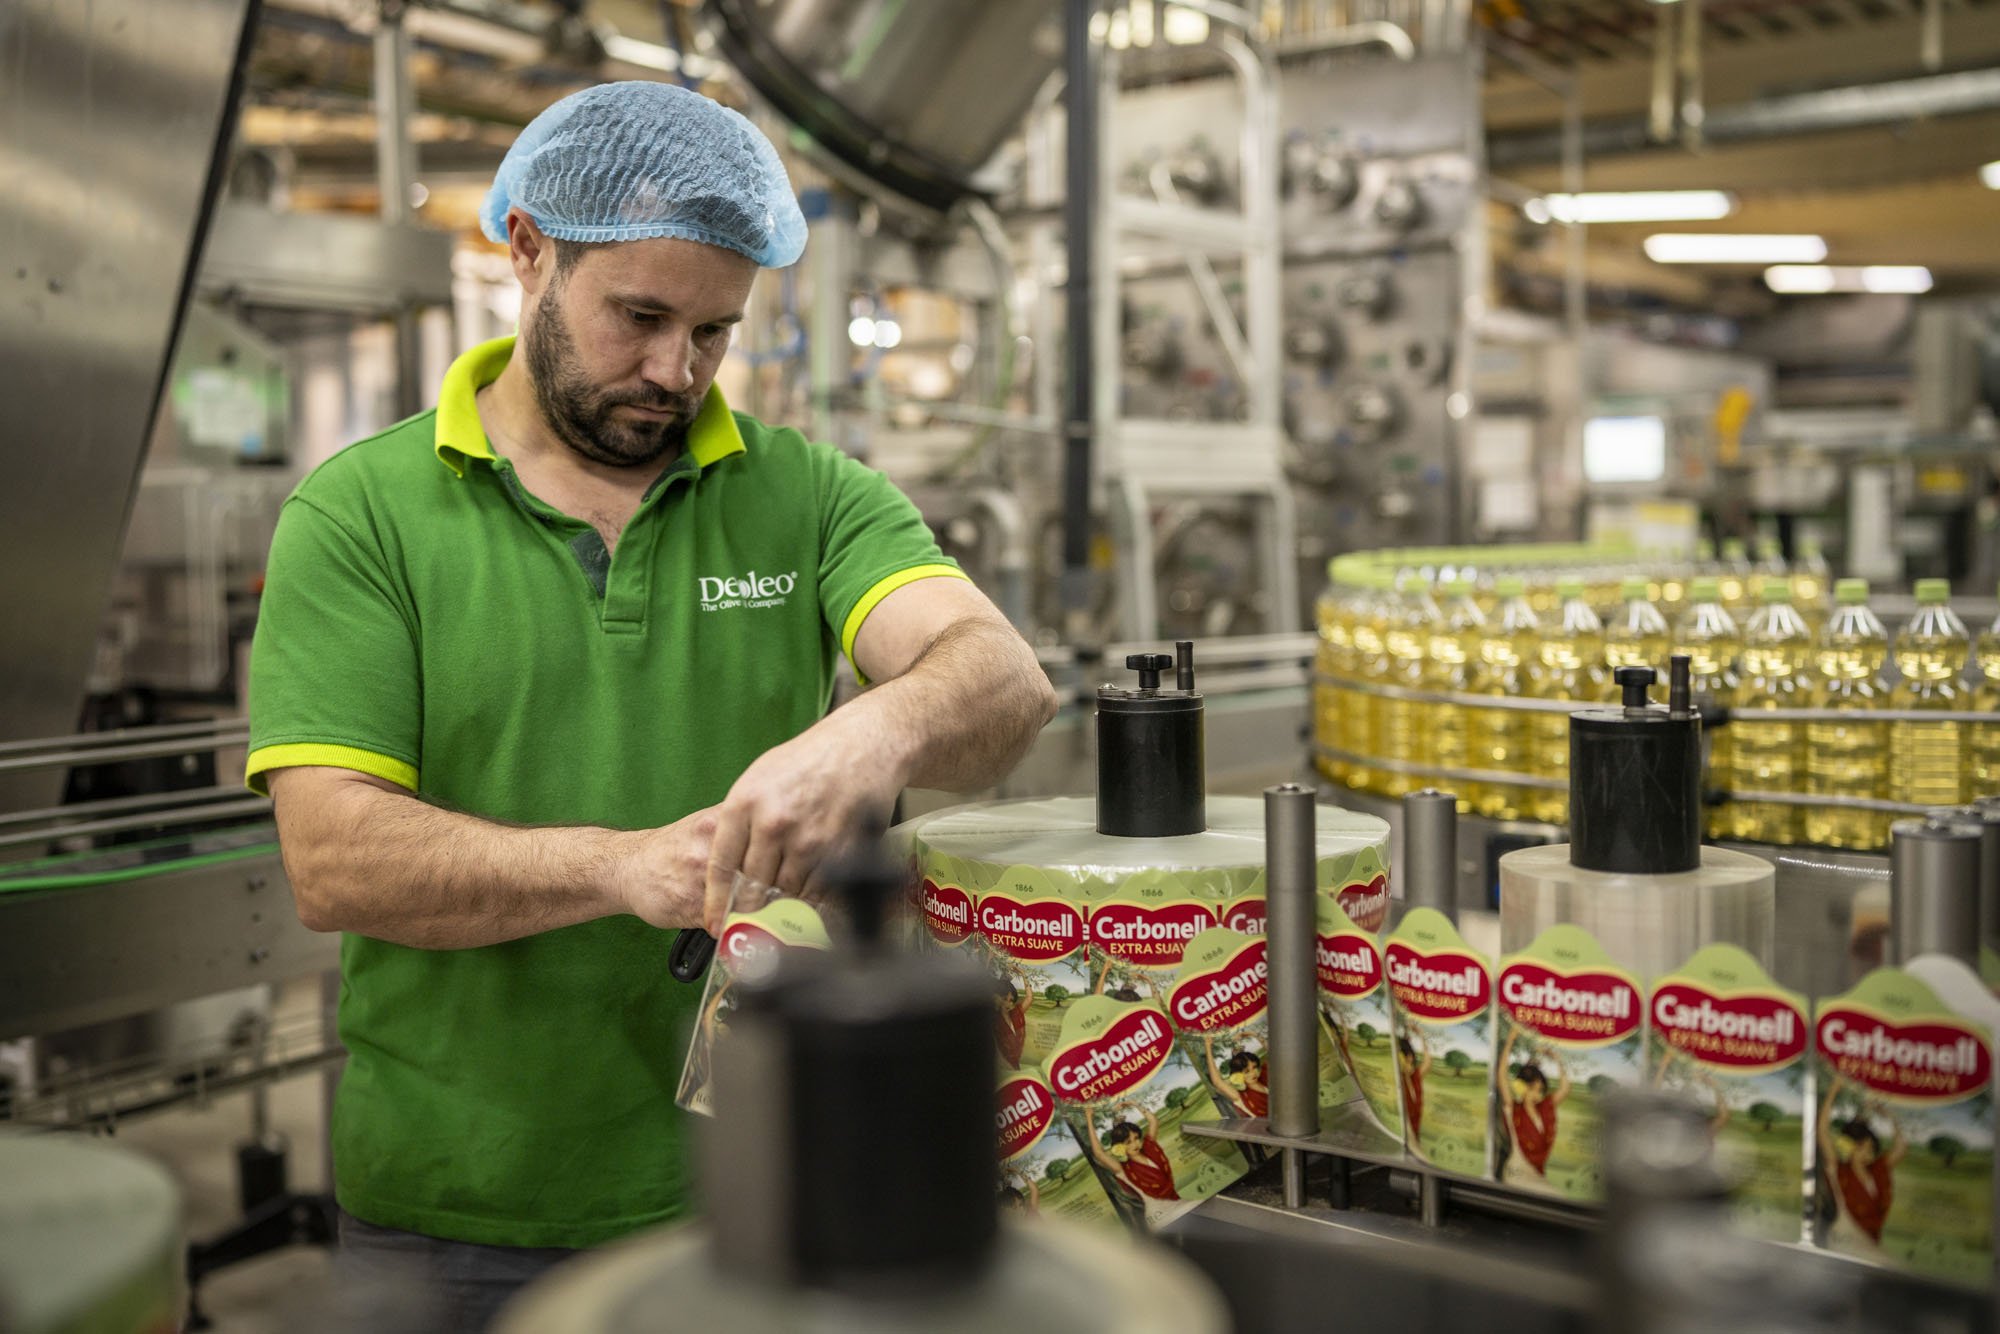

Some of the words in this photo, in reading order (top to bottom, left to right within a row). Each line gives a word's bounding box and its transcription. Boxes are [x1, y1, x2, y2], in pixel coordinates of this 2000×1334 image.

[701, 603, 718, 612] The
[719, 600, 742, 610] Olive
[1015, 884, 1034, 893] 1866
[1140, 889, 1163, 897] 1866
[923, 889, 968, 924] Carbonell
[926, 914, 941, 930] EXTRA
[941, 922, 962, 937] SUAVE
[982, 907, 1074, 938] Carbonell
[992, 933, 1026, 948] EXTRA
[1027, 938, 1064, 952] SUAVE
[1110, 942, 1153, 955] EXTRA
[1154, 942, 1186, 955] SUAV
[1177, 950, 1268, 1021] Carbone
[1386, 953, 1480, 997] Carbonell
[1424, 991, 1468, 1012] SUAVE
[1502, 973, 1631, 1019] Carbonell
[1200, 1000, 1243, 1030] EXTRA
[1515, 1006, 1566, 1030] EXTRA
[1563, 1013, 1616, 1036] SUAVE
[1655, 993, 1794, 1045] Carbonell
[1057, 1015, 1163, 1091] Carbonell
[1821, 1018, 1978, 1076] Carbonell
[1080, 1069, 1123, 1100] EXTRA
[1120, 1045, 1161, 1076] SUAVE
[995, 1085, 1044, 1129] onell
[1004, 1115, 1042, 1143] SUAVE
